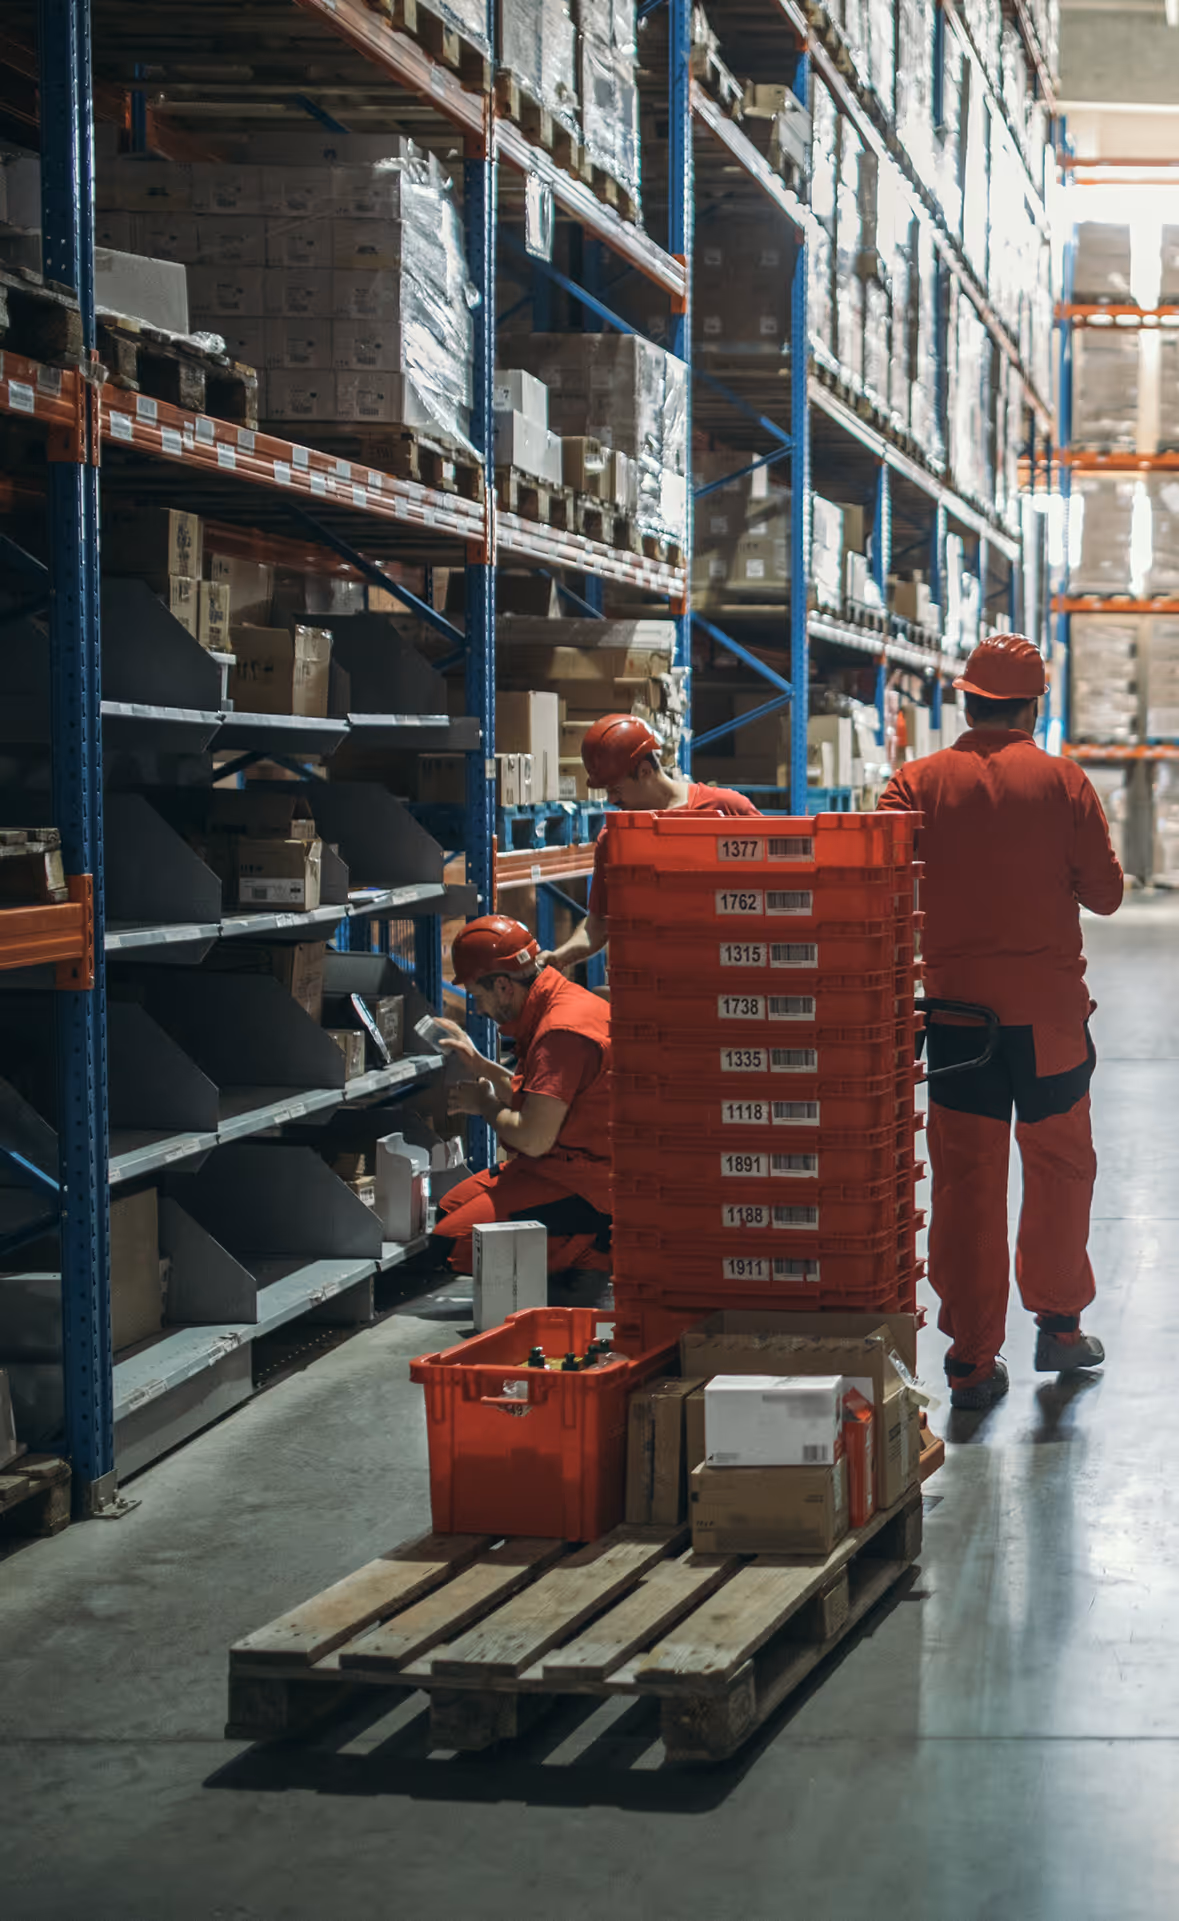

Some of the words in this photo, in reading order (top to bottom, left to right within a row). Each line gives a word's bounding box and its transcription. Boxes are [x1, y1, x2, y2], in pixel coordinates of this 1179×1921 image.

[722, 840, 758, 857] 1377
[721, 893, 757, 910] 1762
[725, 945, 761, 962] 1315
[723, 998, 759, 1015] 1738
[725, 1050, 762, 1068] 1335
[727, 1103, 763, 1120] 1118
[726, 1155, 761, 1173] 1891
[727, 1206, 763, 1223] 1188
[728, 1259, 762, 1276] 1911
